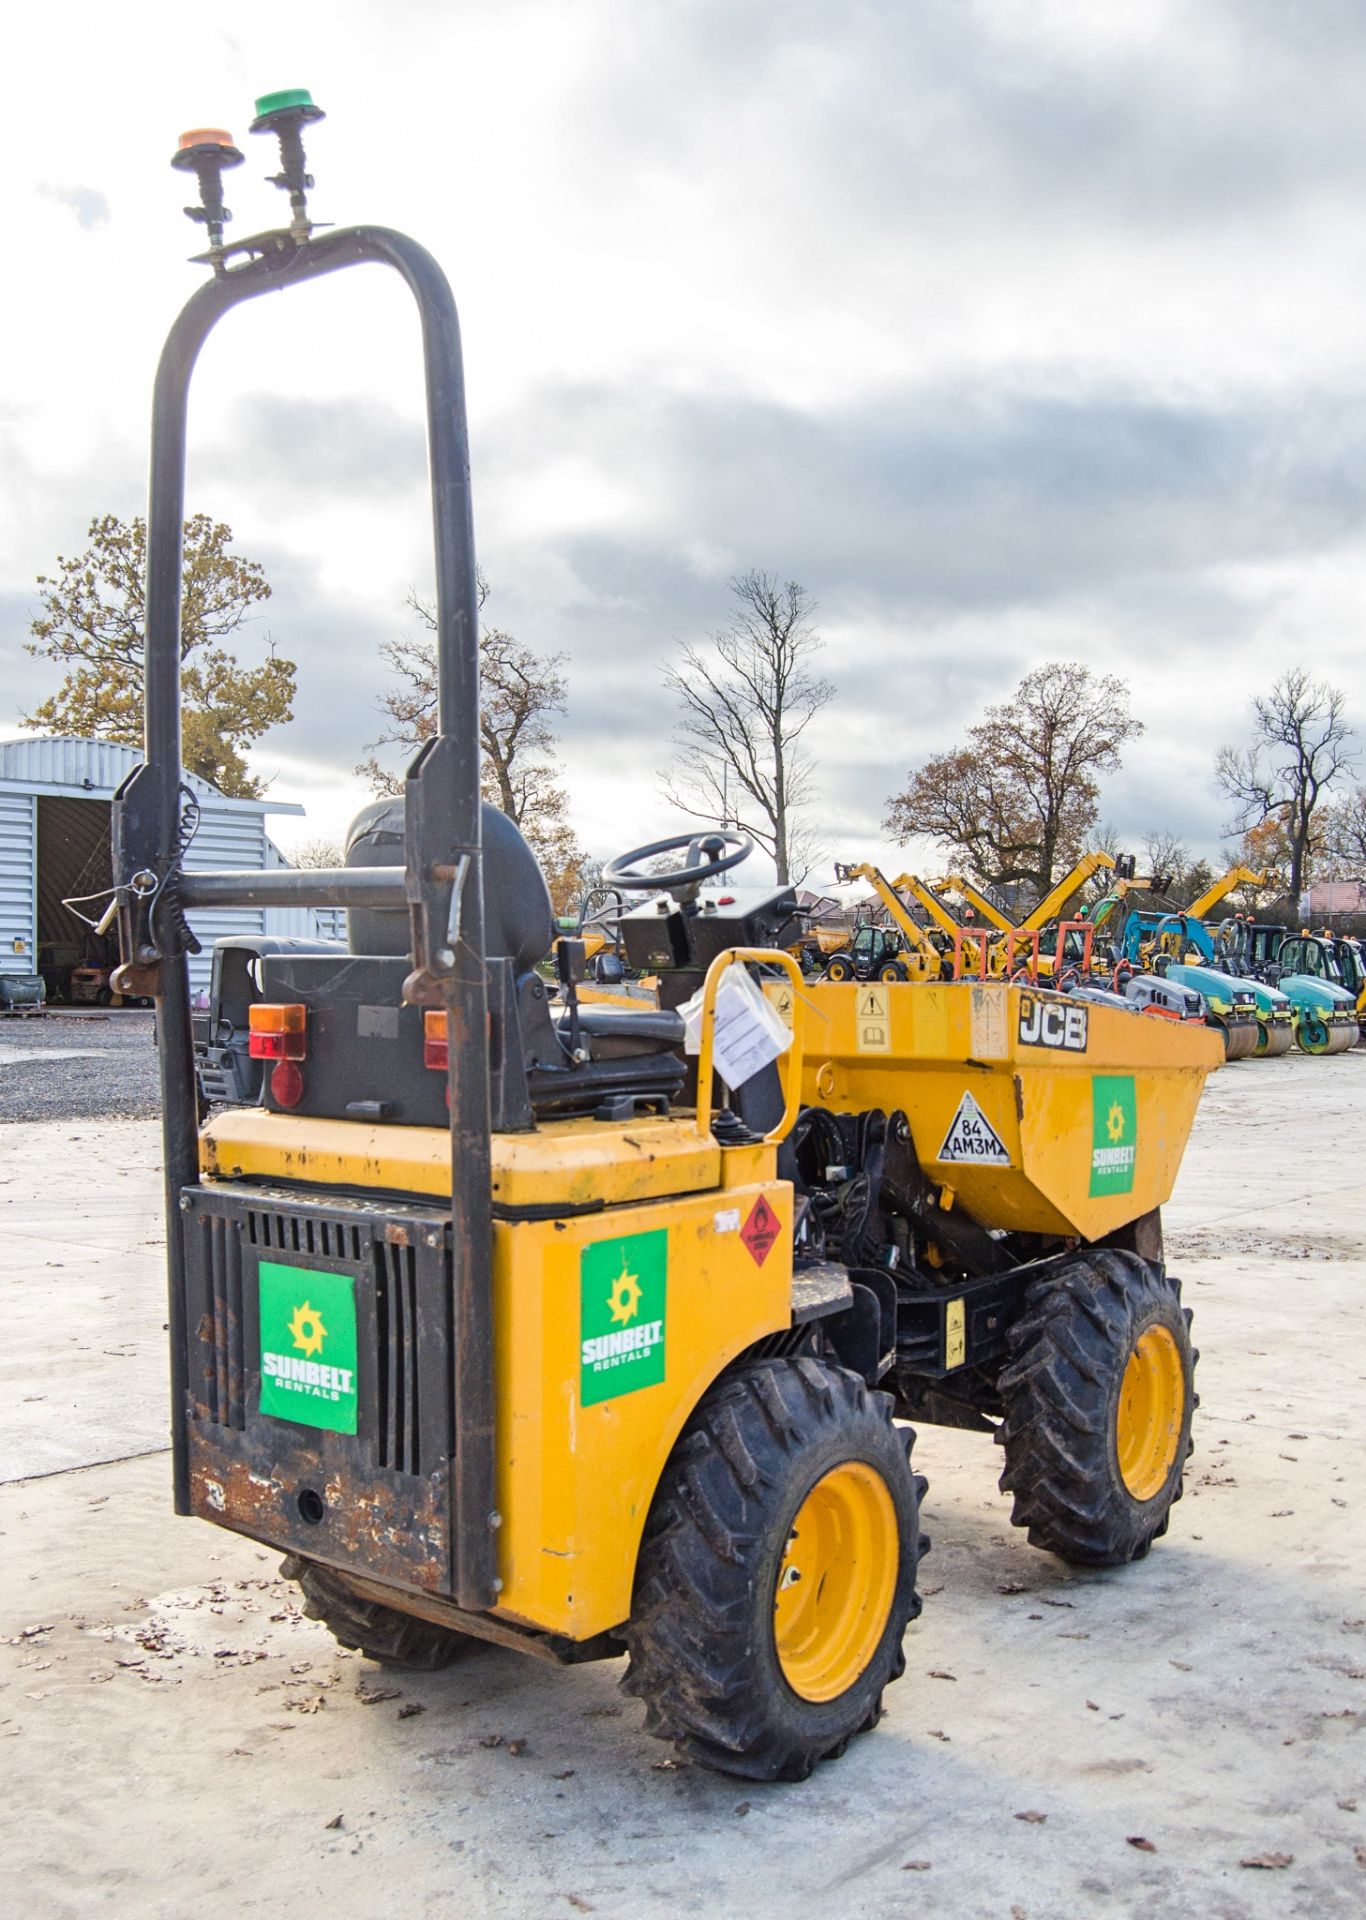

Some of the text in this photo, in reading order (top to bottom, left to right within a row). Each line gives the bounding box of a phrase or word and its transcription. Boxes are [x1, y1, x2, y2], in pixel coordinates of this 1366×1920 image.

[1020, 1001, 1087, 1049] JCB
[962, 1119, 981, 1136] 84
[953, 1137, 997, 1155] AM3M
[1093, 1145, 1135, 1168] SUNBELT
[582, 1320, 662, 1365] SUNBELT
[263, 1351, 353, 1393] SUNBELT
[593, 1347, 651, 1373] RENTALS
[274, 1377, 340, 1402] RENTALS
